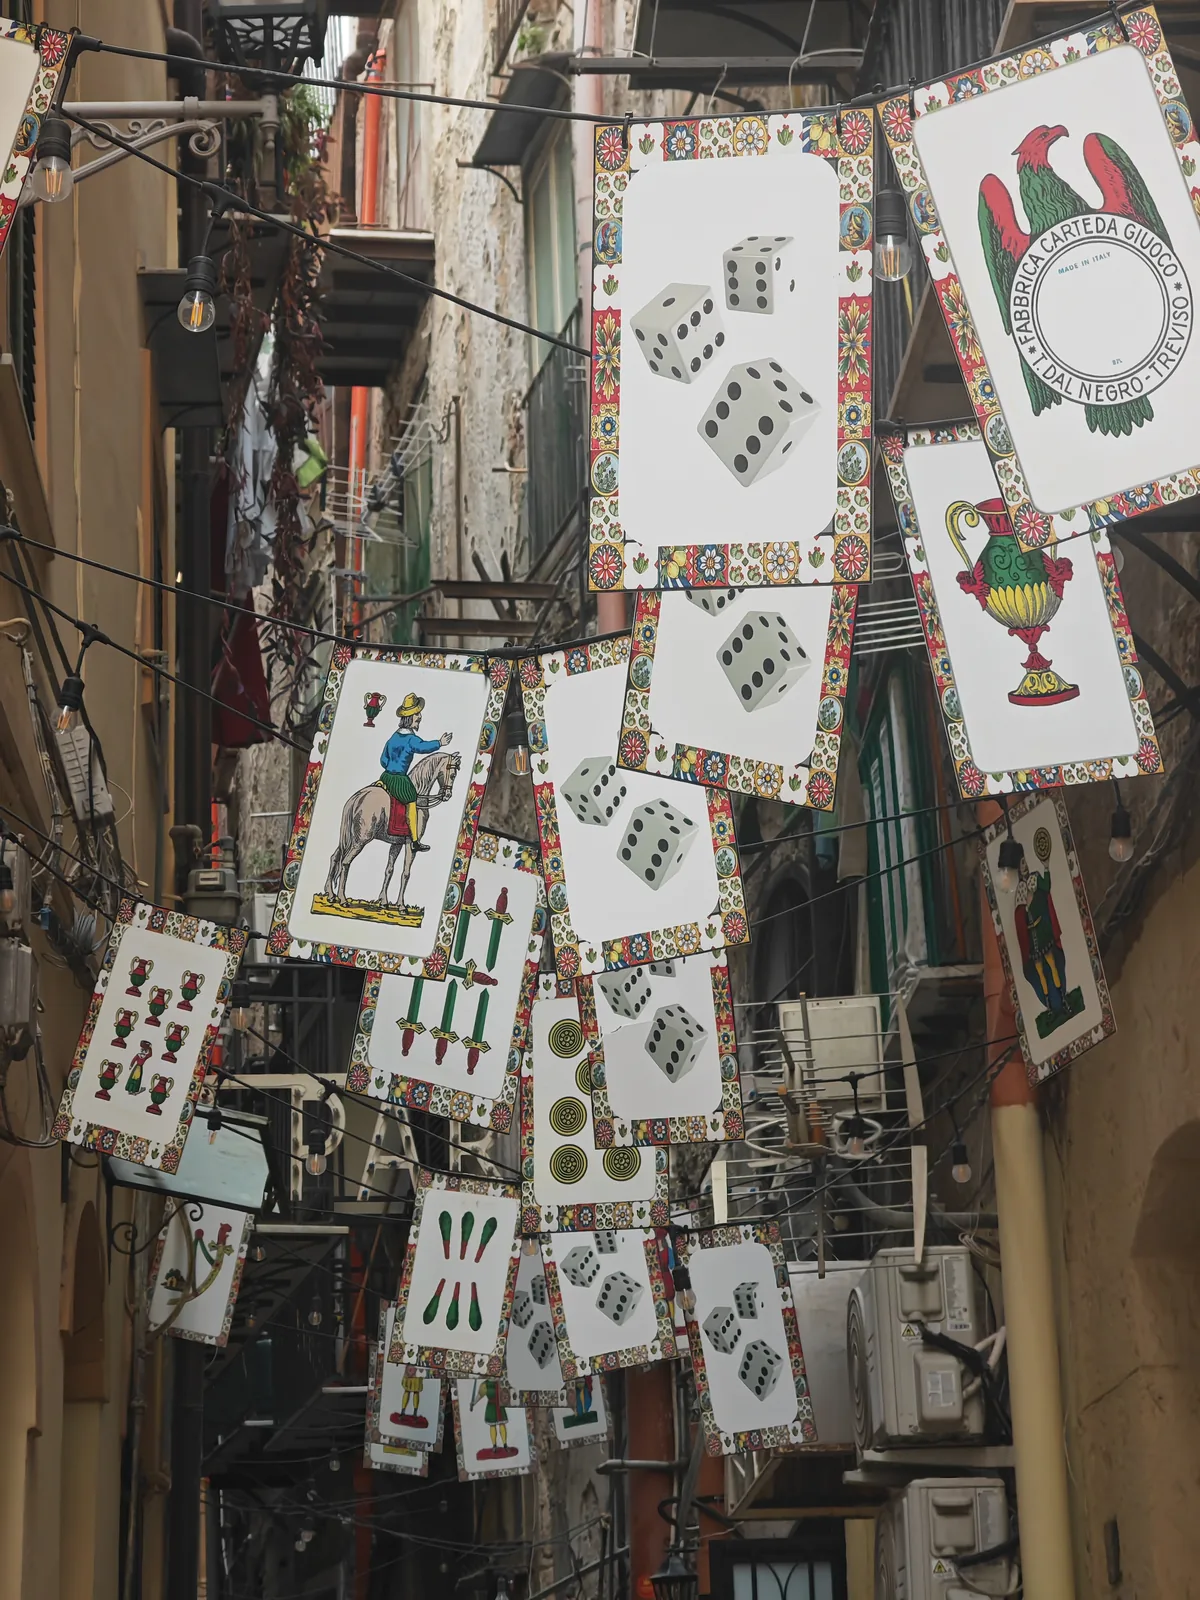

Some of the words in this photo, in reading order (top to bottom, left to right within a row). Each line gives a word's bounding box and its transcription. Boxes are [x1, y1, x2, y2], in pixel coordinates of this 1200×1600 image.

[1014, 254, 1045, 345] FABBRICA
[1124, 223, 1178, 277] GIUOCO
[1058, 263, 1079, 274] MADE
[1081, 259, 1090, 267] IN
[1092, 252, 1111, 262] ITALY
